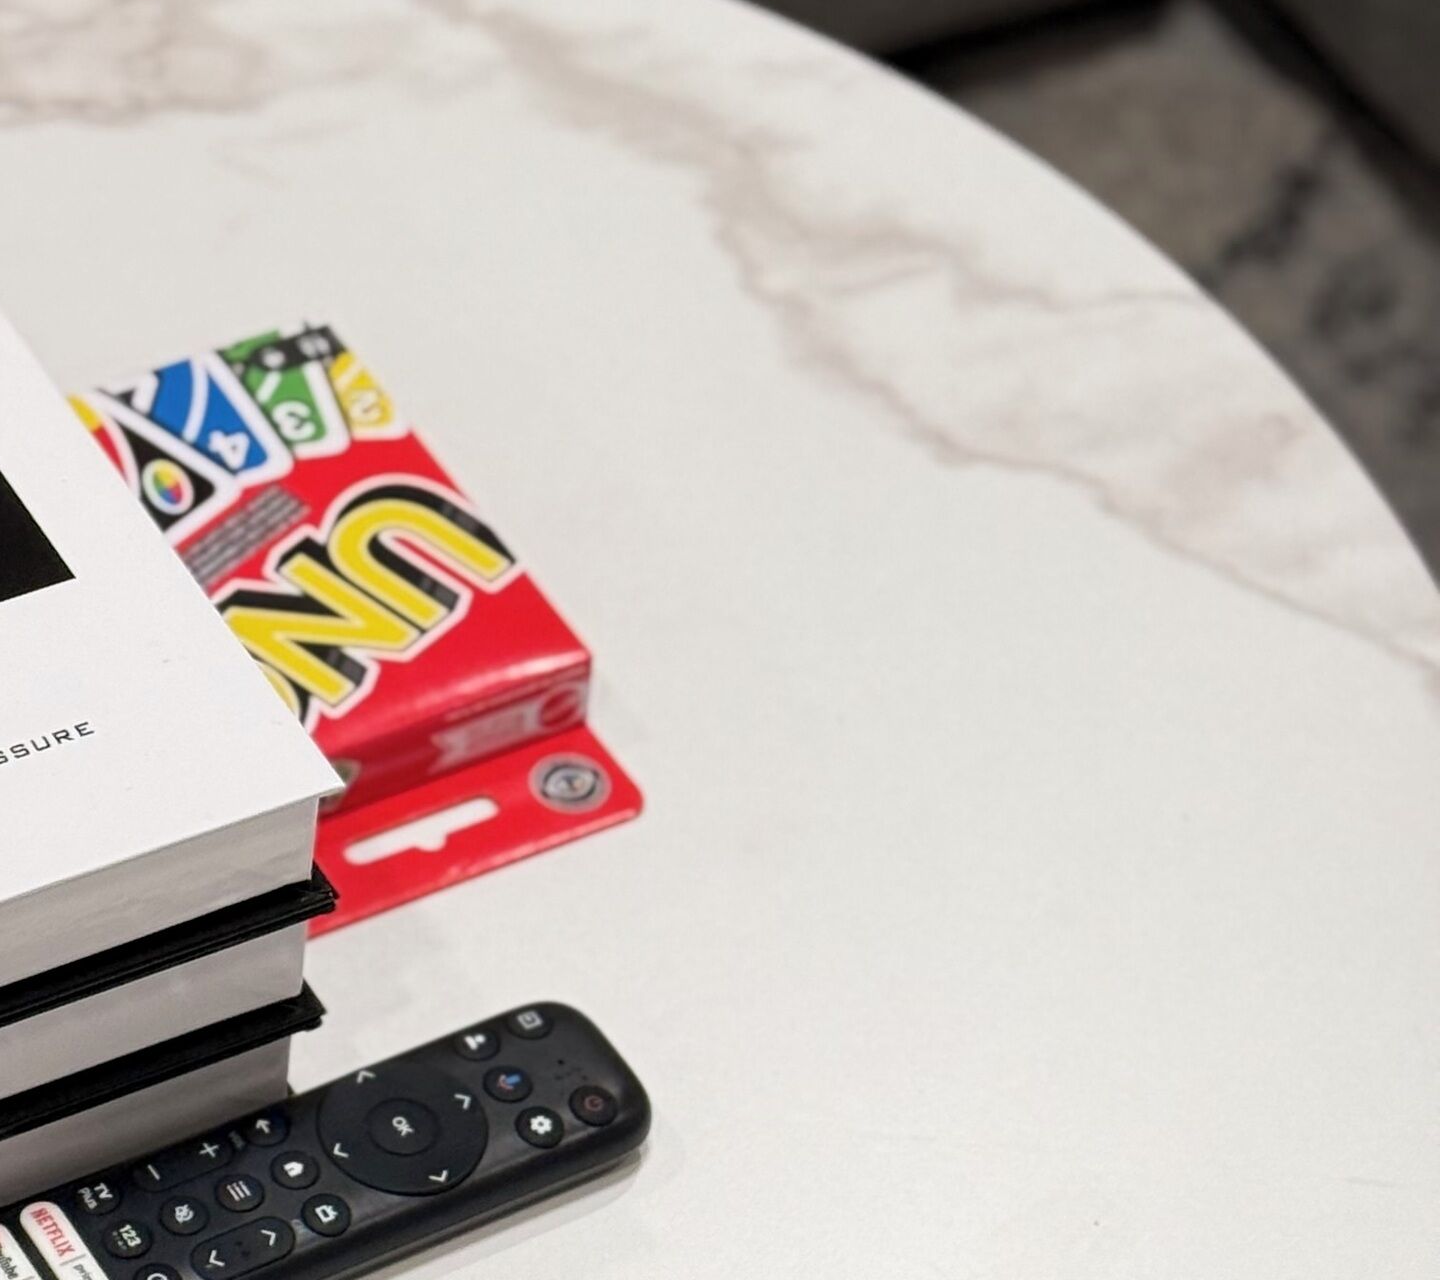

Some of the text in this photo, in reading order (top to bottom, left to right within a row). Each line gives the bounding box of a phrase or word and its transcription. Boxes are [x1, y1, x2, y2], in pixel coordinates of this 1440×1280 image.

[273, 401, 316, 441] 3
[209, 430, 250, 469] 4
[221, 486, 514, 718] UN
[392, 1116, 414, 1136] OK
[94, 1183, 113, 1200] TV
[30, 1208, 76, 1257] NETFLIX
[119, 1224, 142, 1246] 123
